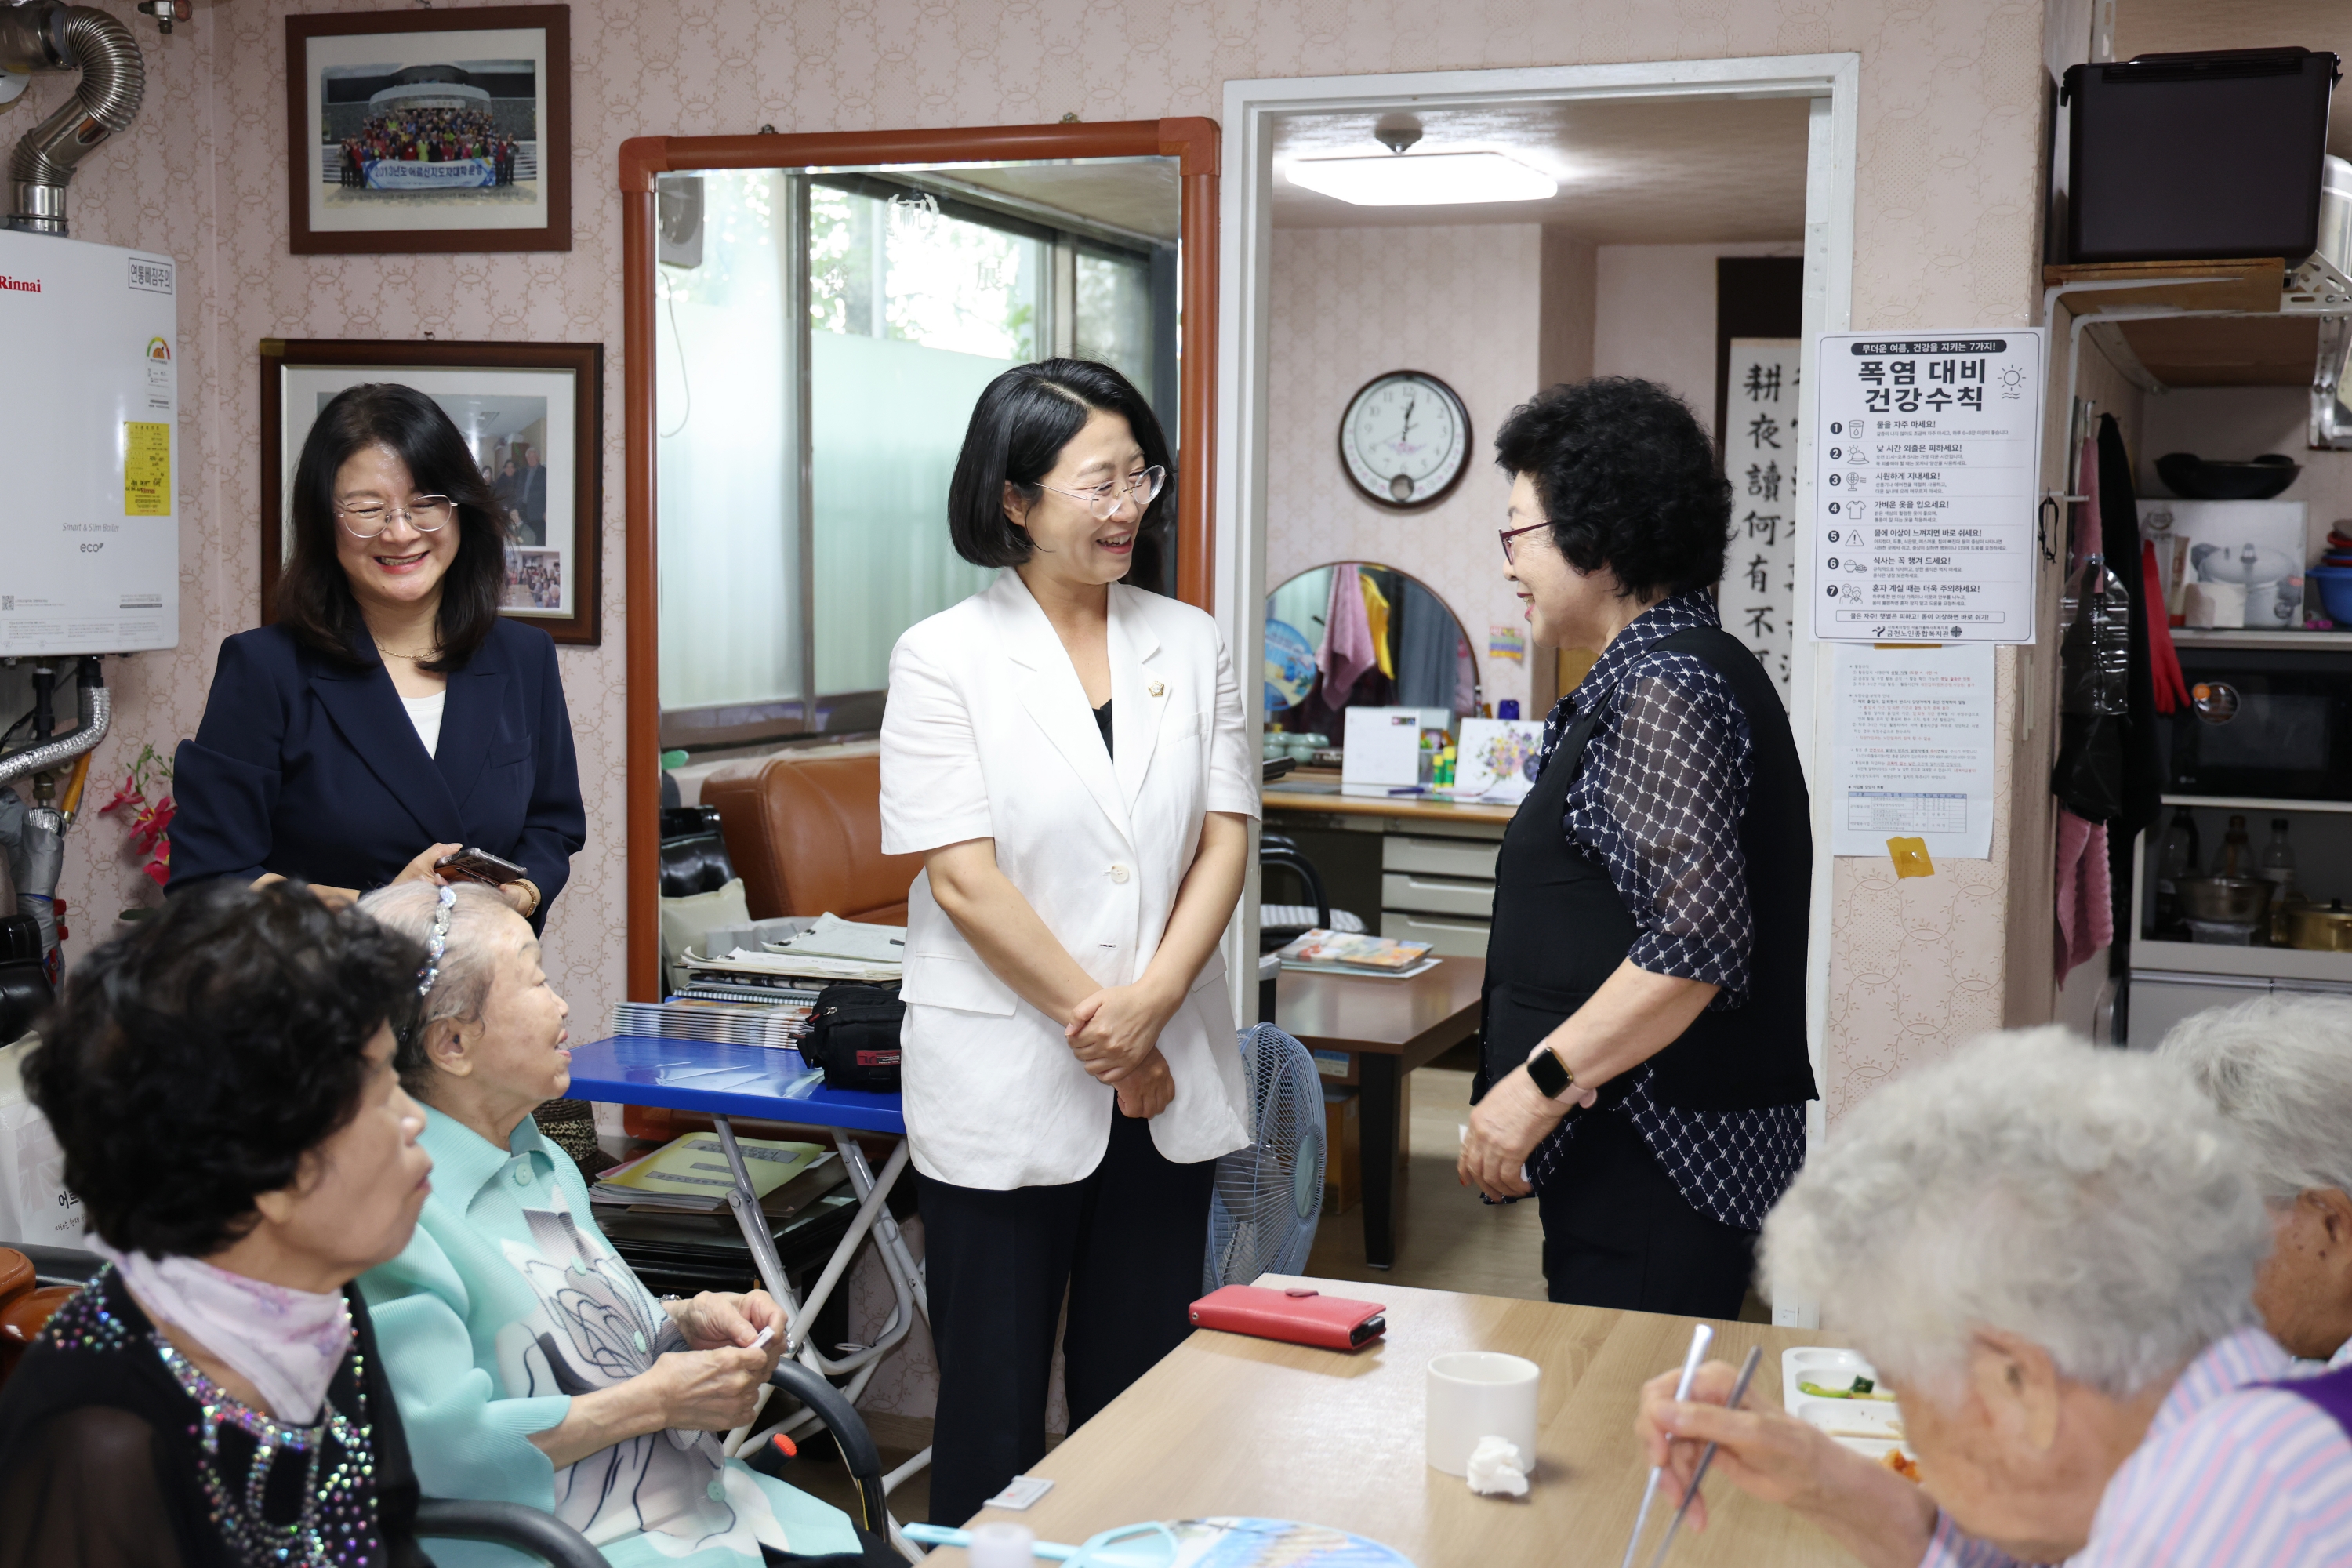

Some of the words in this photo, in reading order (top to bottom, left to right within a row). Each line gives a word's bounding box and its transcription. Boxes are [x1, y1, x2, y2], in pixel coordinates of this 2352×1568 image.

[131, 263, 170, 289] 연통빠짐주의
[974, 260, 1004, 292] 展
[0, 275, 42, 293] Rinnai
[1862, 343, 1887, 354] 무더운
[1889, 343, 1910, 354] 여름,
[1913, 343, 1938, 353] 건강을
[1941, 342, 1966, 352] 지키는
[1969, 342, 1996, 351] 7가지!
[1858, 360, 1915, 386] 폭염
[1929, 359, 1986, 385] 대비
[1864, 387, 1983, 413] 건강수칙
[1877, 420, 1891, 429] 물을
[1904, 444, 1926, 452] 외출은
[1899, 500, 1913, 509] 옷을
[63, 523, 82, 532] Smart
[89, 523, 101, 532] Slim
[103, 524, 119, 532] Boiler
[80, 543, 100, 553] eco
[1906, 584, 1920, 593] 때는
